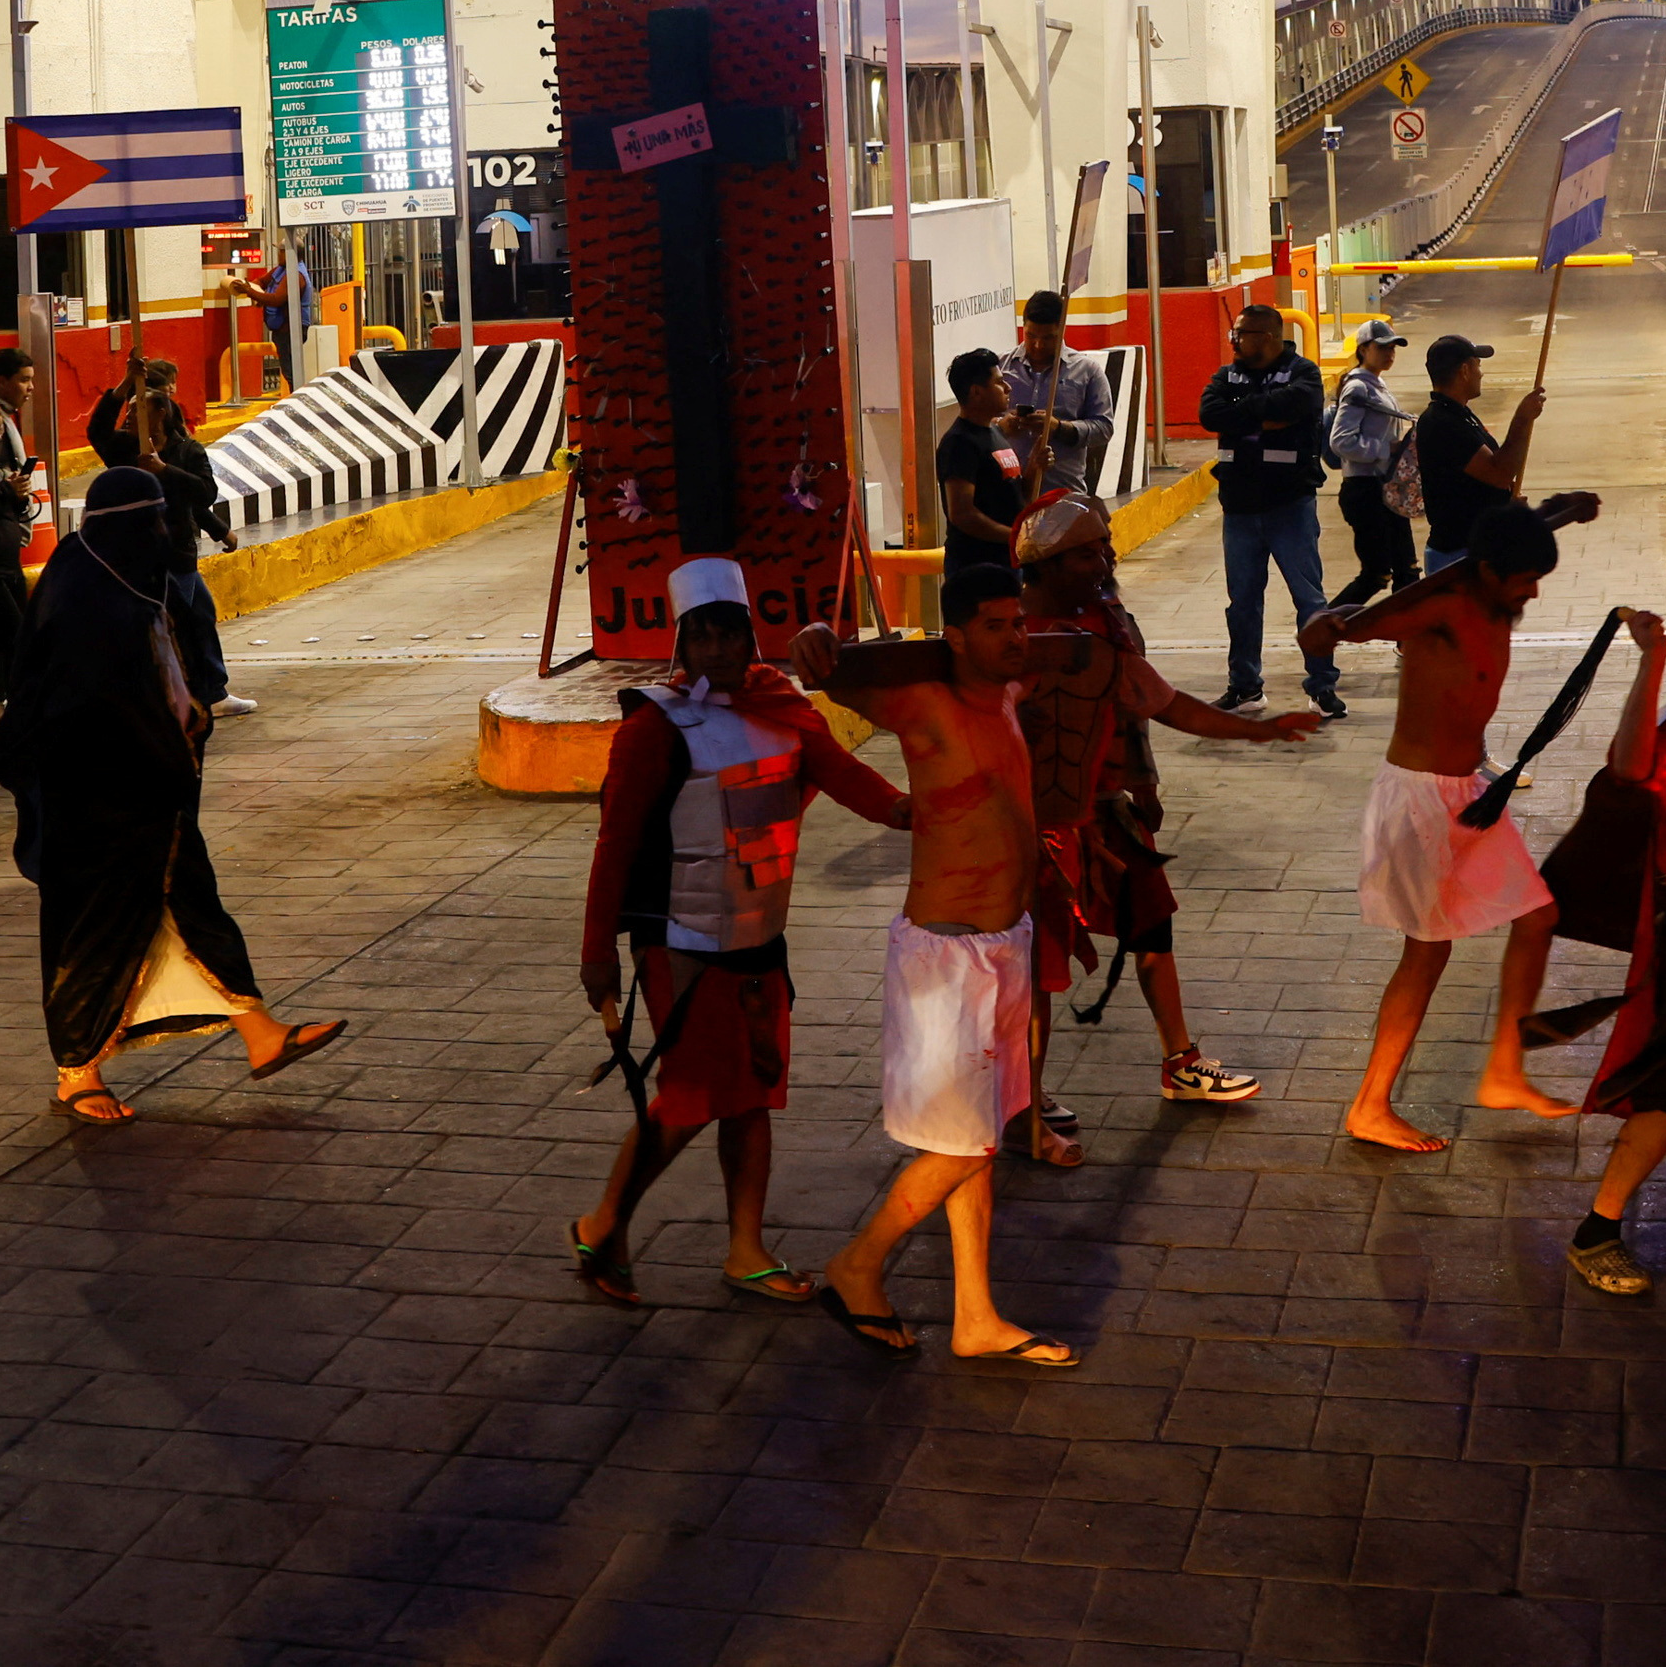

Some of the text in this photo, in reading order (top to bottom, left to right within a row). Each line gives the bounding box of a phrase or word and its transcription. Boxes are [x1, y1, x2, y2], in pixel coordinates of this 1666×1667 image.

[361, 35, 445, 49] PESOS DOLARES
[279, 60, 308, 70] PEATON
[280, 79, 334, 91] MOTOCICLETAS
[281, 102, 306, 111] AUTOS
[282, 117, 317, 127] AUTOBUS
[303, 127, 309, 135] 4
[310, 125, 329, 135] EJES
[283, 134, 351, 147] CAMION DE CARGA
[284, 146, 324, 157] 2 A 9 EJES
[284, 156, 343, 168] EJE EXCEDENTE
[285, 168, 311, 177] LIGERO
[467, 155, 537, 188] 102
[285, 177, 344, 188] EJE EXCEDENTE
[286, 187, 323, 198] DE CARGA
[303, 201, 325, 210] SCT
[948, 292, 993, 322] FRONTERIZO
[594, 575, 852, 634] Jucia
